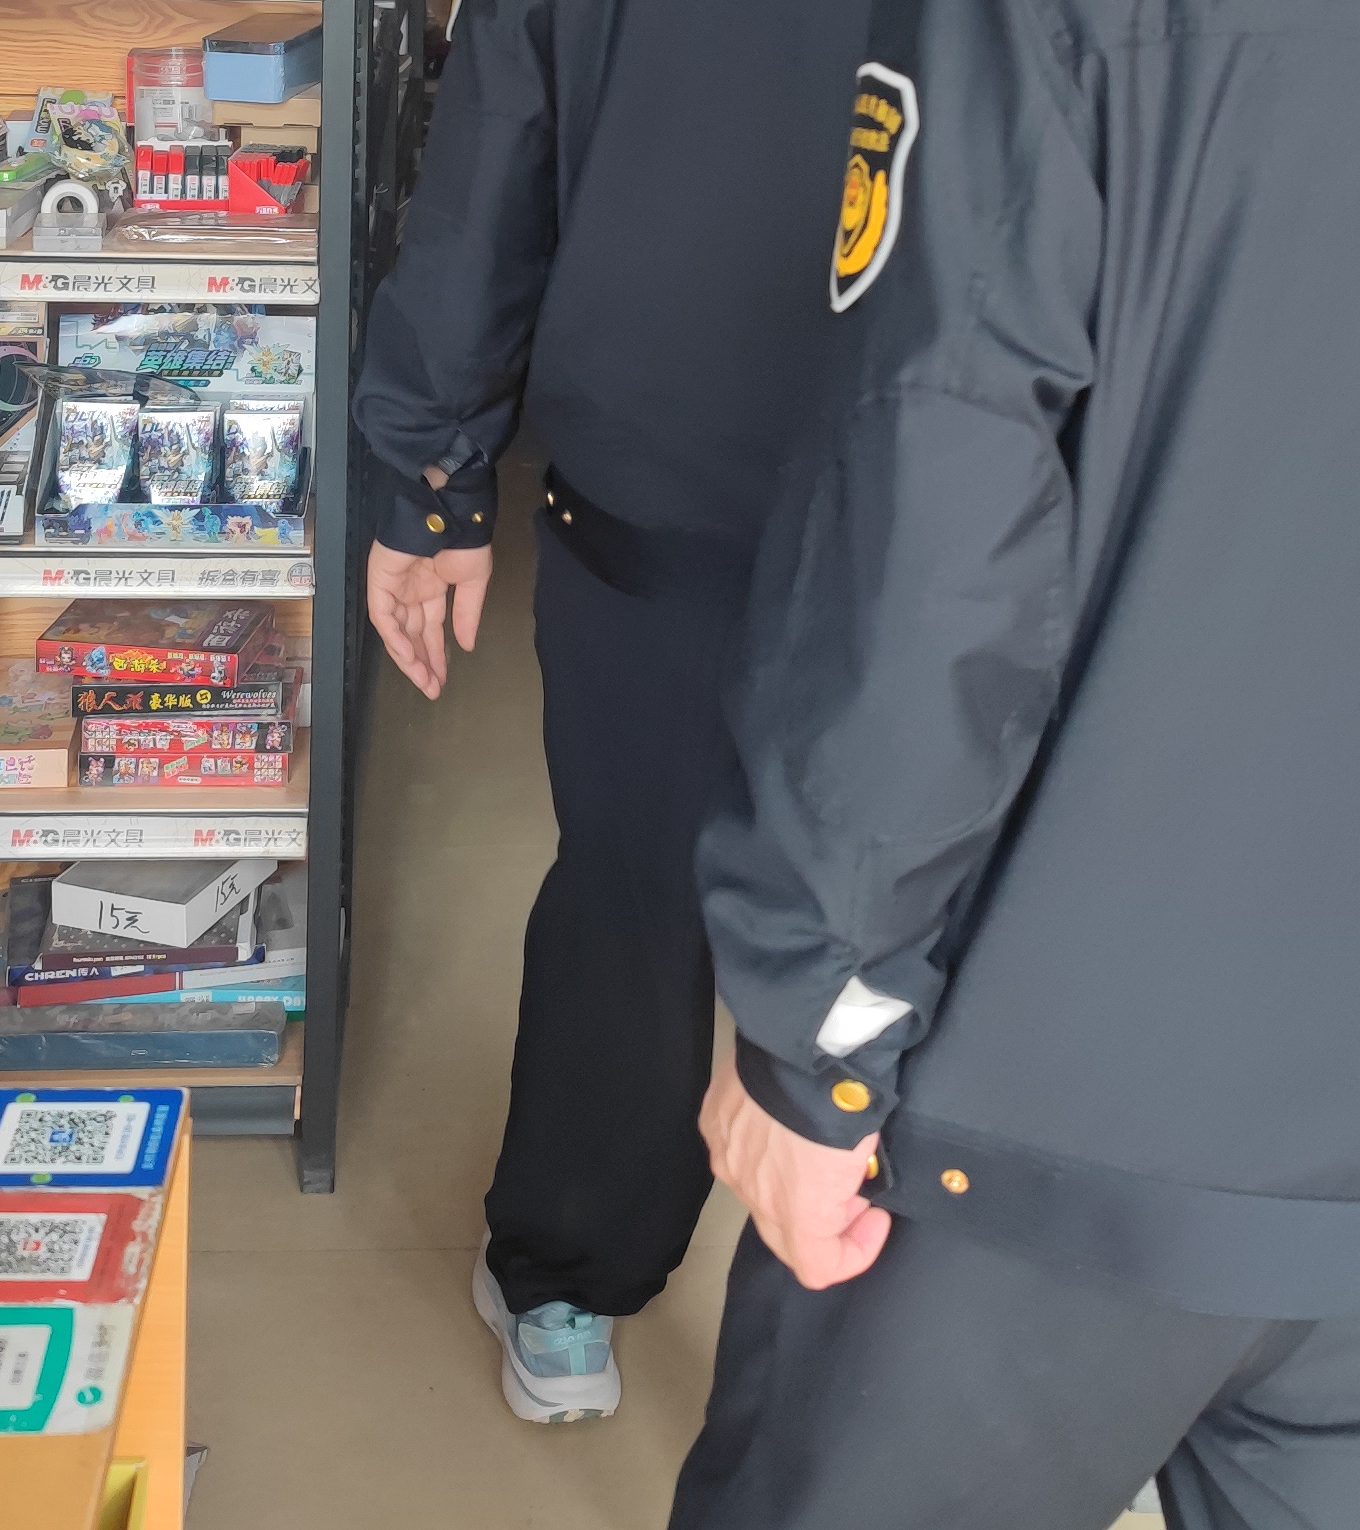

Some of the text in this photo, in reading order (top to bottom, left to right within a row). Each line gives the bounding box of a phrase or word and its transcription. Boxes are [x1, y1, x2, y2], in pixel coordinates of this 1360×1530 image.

[18, 272, 158, 294] M&G晨光文具
[41, 566, 281, 588] M&G晨光文具 拆盒有喜
[76, 688, 278, 713] 狼人杀 豪华版 Werewolves
[10, 827, 144, 849] M&G晨光文具
[97, 899, 151, 935] 15元
